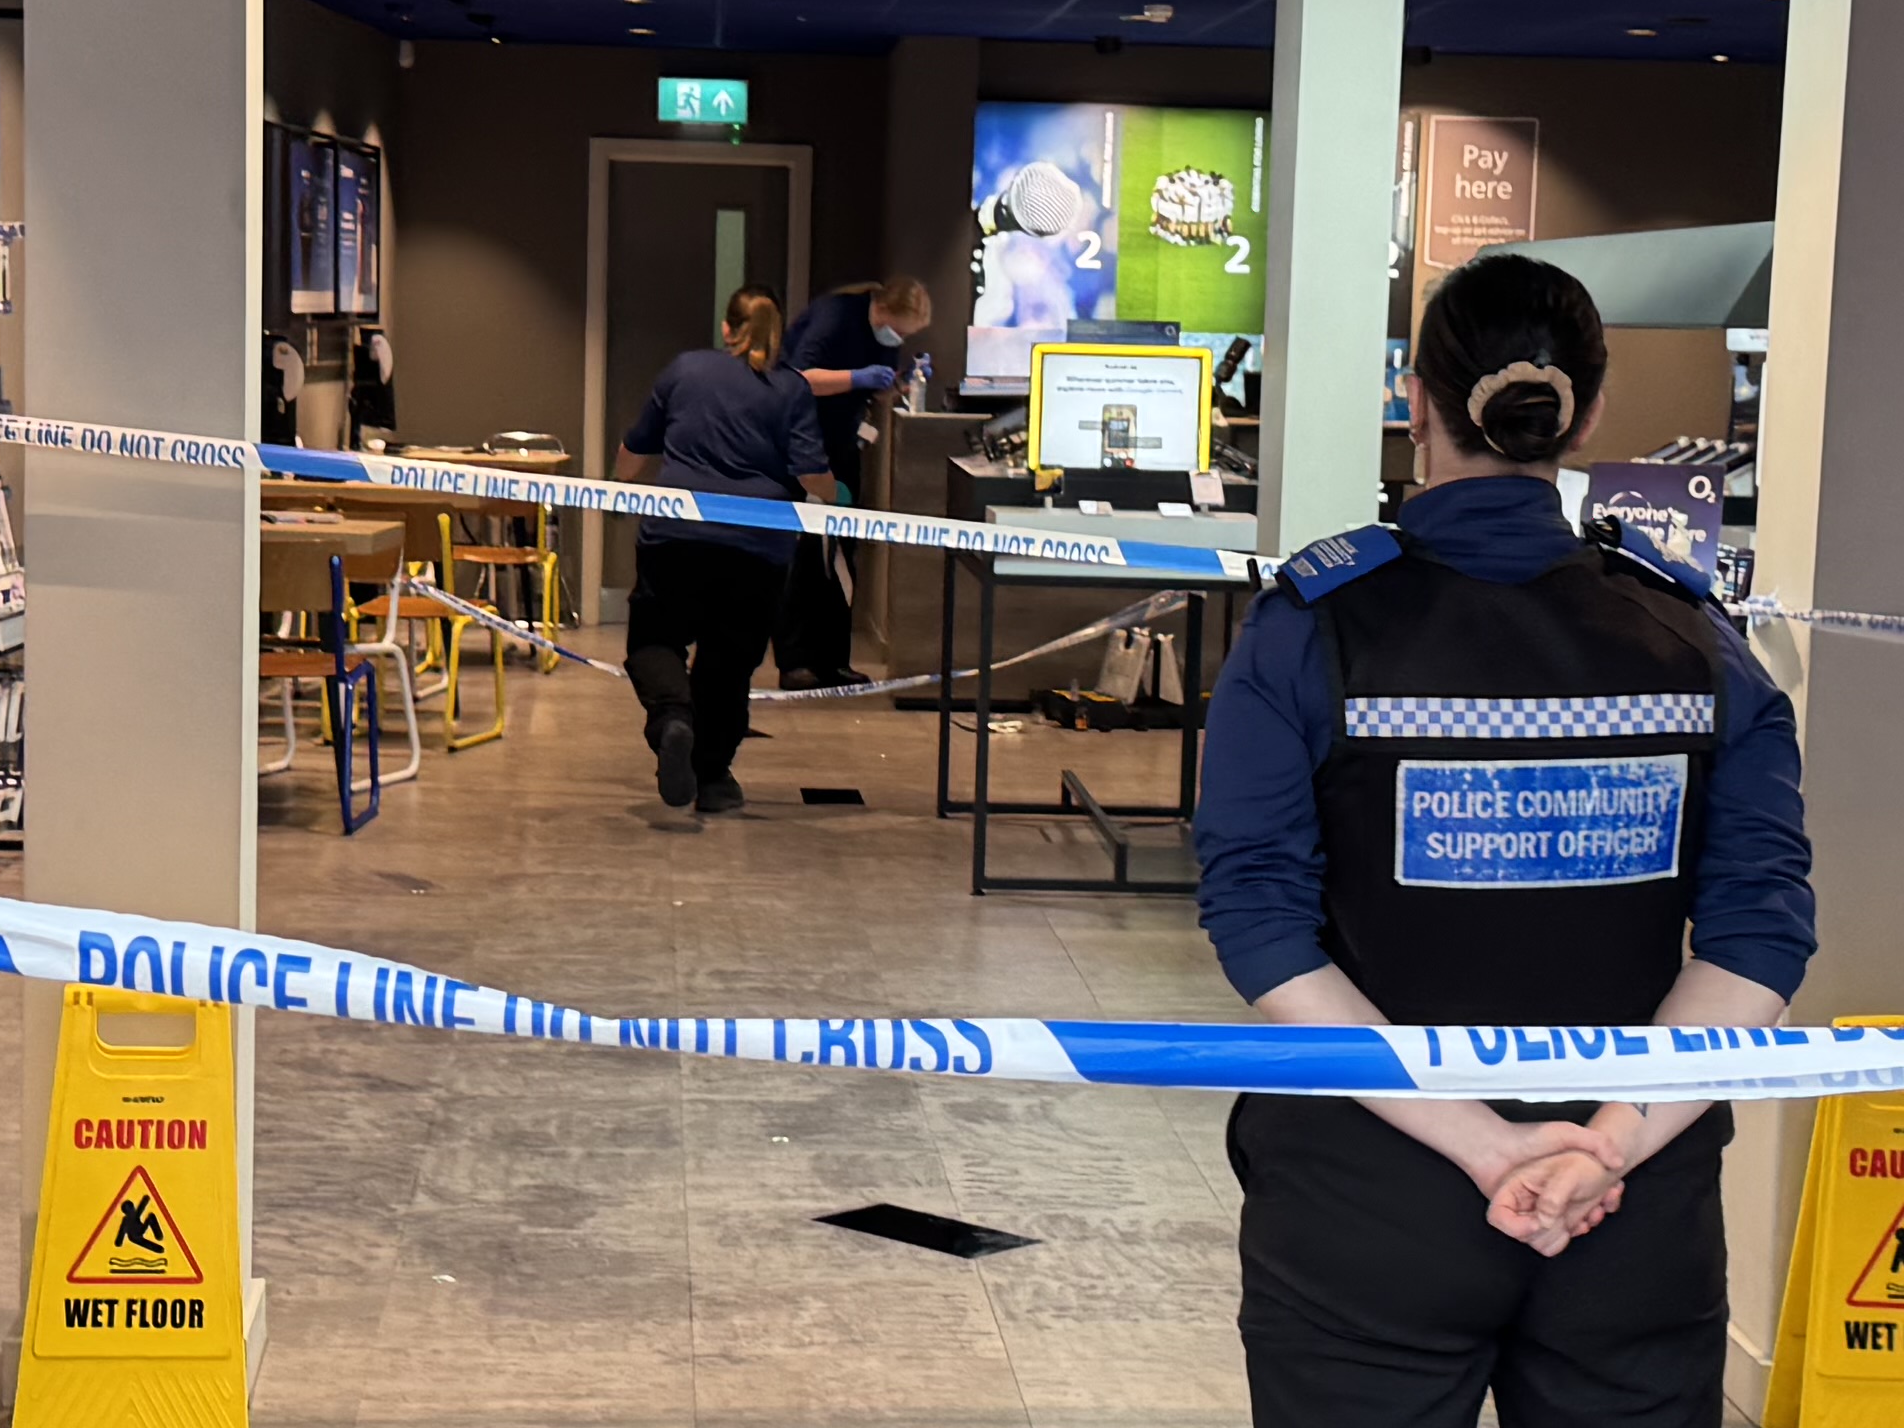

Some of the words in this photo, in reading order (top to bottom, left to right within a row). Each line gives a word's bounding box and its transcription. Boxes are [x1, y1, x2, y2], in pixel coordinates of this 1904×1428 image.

[1463, 144, 1509, 175] Pay
[1454, 173, 1513, 200] here
[25, 421, 74, 449] LINE
[81, 427, 113, 454] DO
[119, 433, 165, 461] NOT
[170, 439, 246, 468] CROSS
[391, 464, 467, 496] POLICE
[472, 474, 521, 501] LINE
[528, 481, 555, 505] DO
[564, 486, 609, 510] NOT
[614, 491, 685, 518] CROSS
[825, 515, 897, 541] POLICE
[904, 524, 949, 547] LINE
[957, 531, 984, 552] DO
[993, 535, 1036, 556] NOT
[1413, 790, 1512, 819] POLICE
[1516, 786, 1671, 818] COMMUNITY
[1425, 830, 1552, 860] SUPPORT
[1556, 826, 1659, 858] OFFICER
[79, 930, 311, 1011] POLICE
[335, 960, 480, 1030] LINE
[773, 1018, 993, 1075] CROSS
[74, 1118, 207, 1149] CAUTION
[64, 1298, 119, 1329] WET
[125, 1298, 205, 1329] FLOOR
[1845, 1320, 1897, 1352] WET
